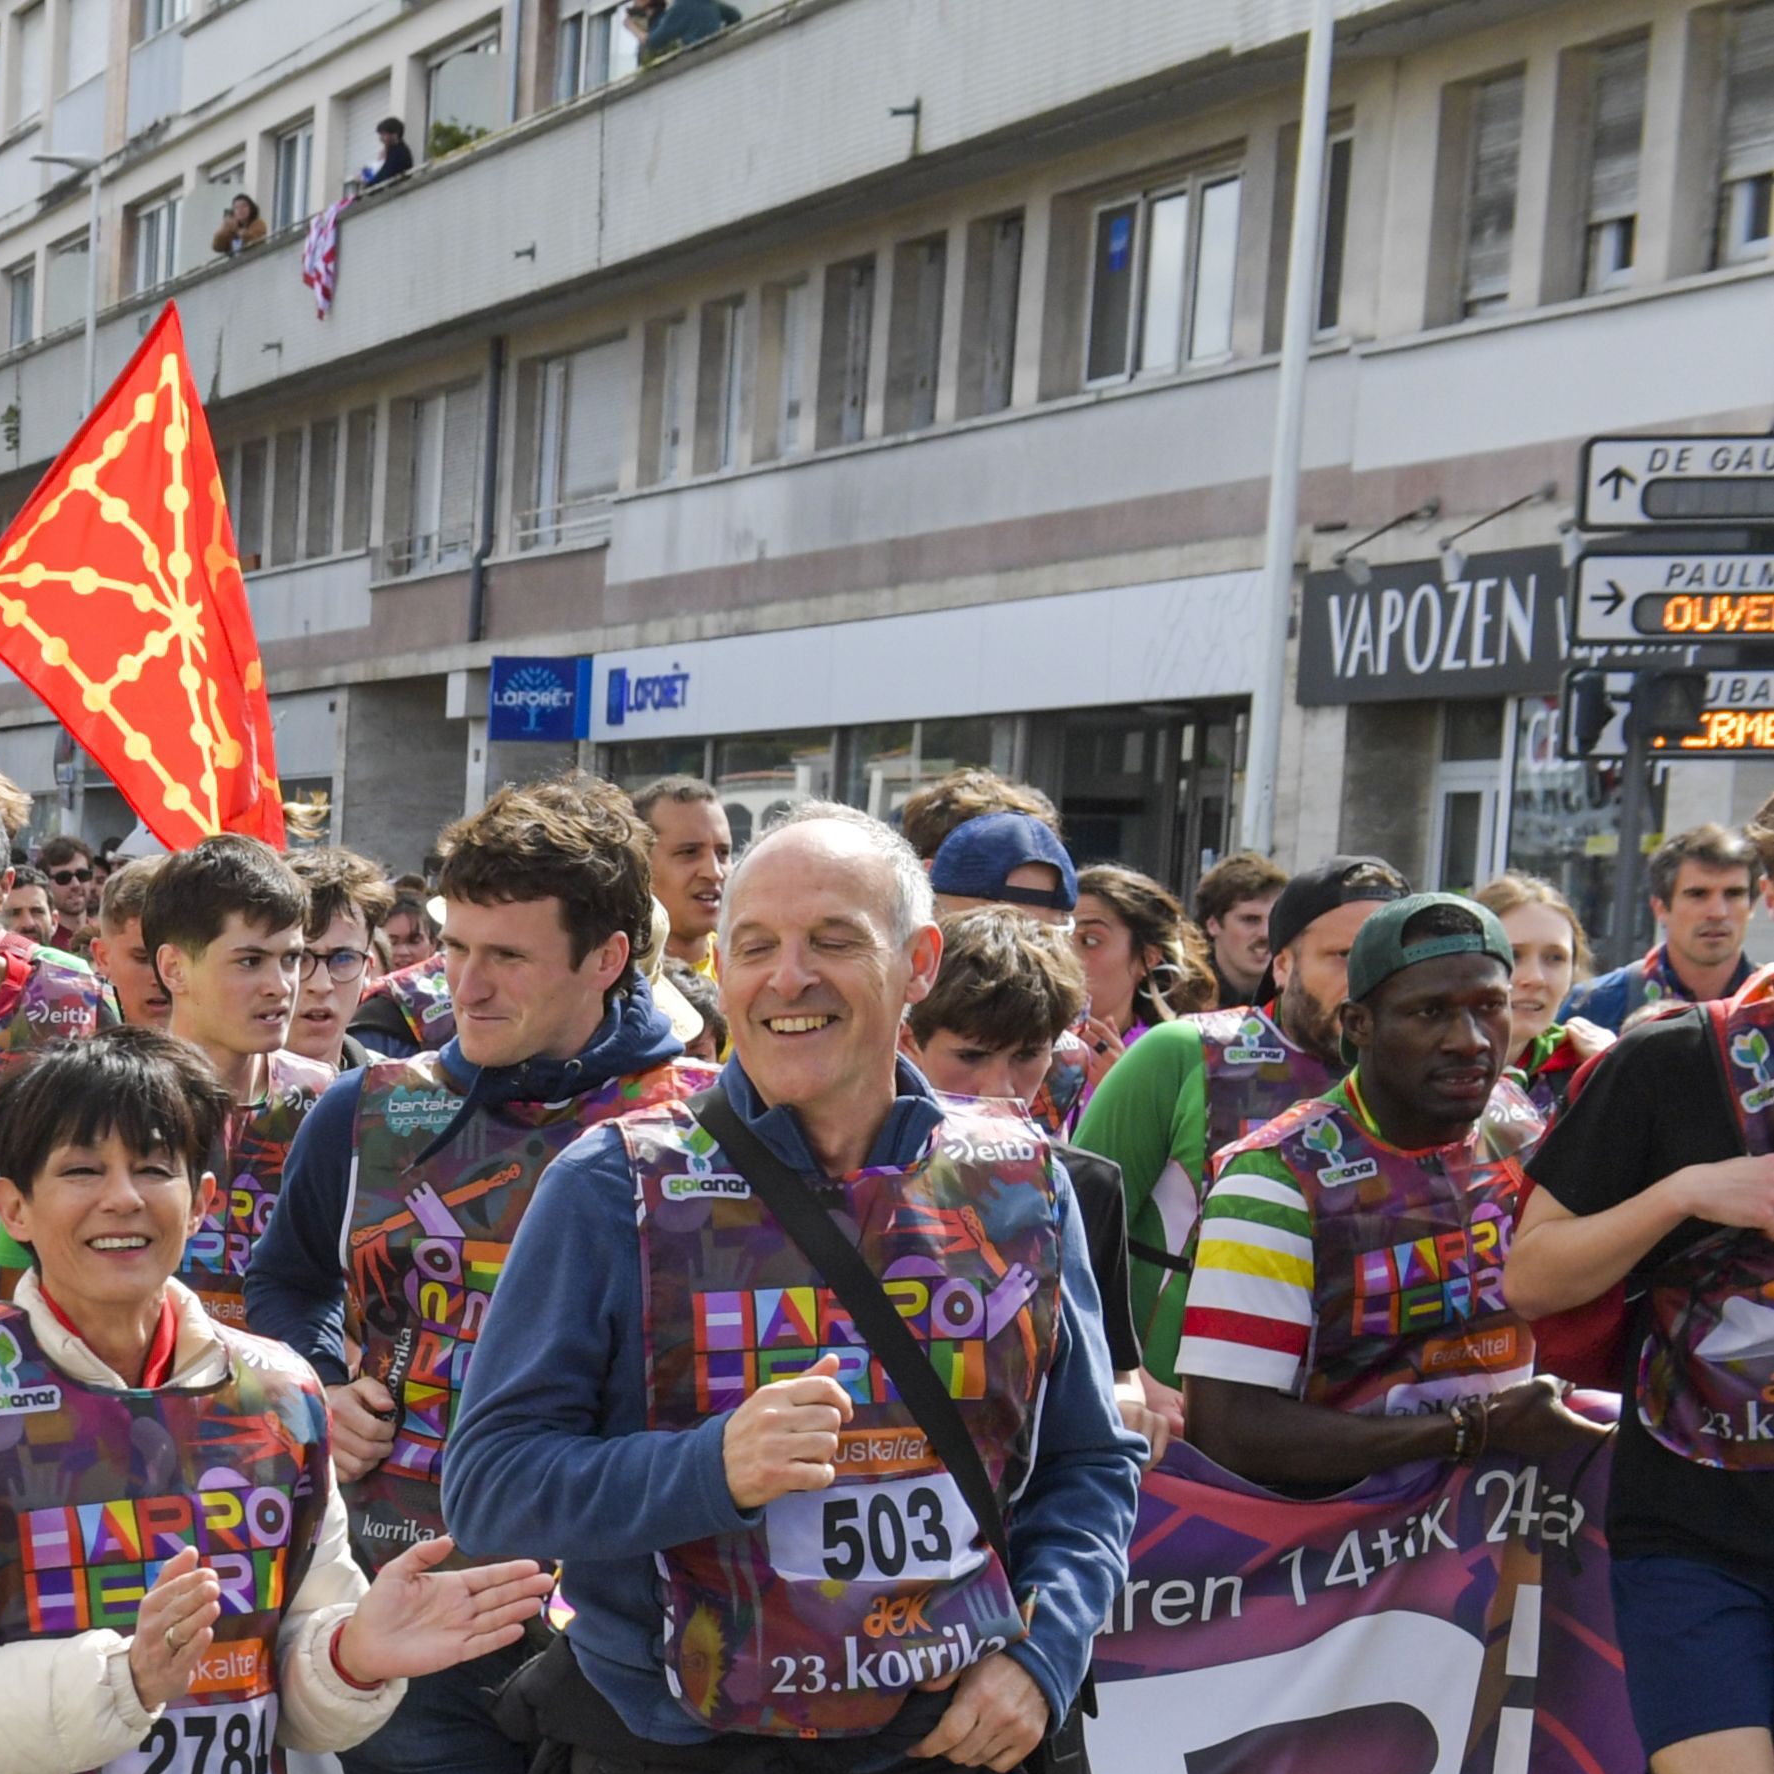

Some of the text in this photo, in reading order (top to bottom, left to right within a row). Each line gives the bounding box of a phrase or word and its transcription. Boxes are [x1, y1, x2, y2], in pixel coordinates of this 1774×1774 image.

[1648, 447, 1692, 473] DE
[1328, 574, 1536, 679] VAPOZEN
[50, 1006, 92, 1026] eitb
[388, 1097, 464, 1113] bertako
[982, 1139, 1036, 1163] eitb
[1431, 1334, 1510, 1366] euskaltel
[362, 1514, 436, 1545] korrika
[821, 1486, 952, 1581] 503
[864, 1595, 933, 1640] aek
